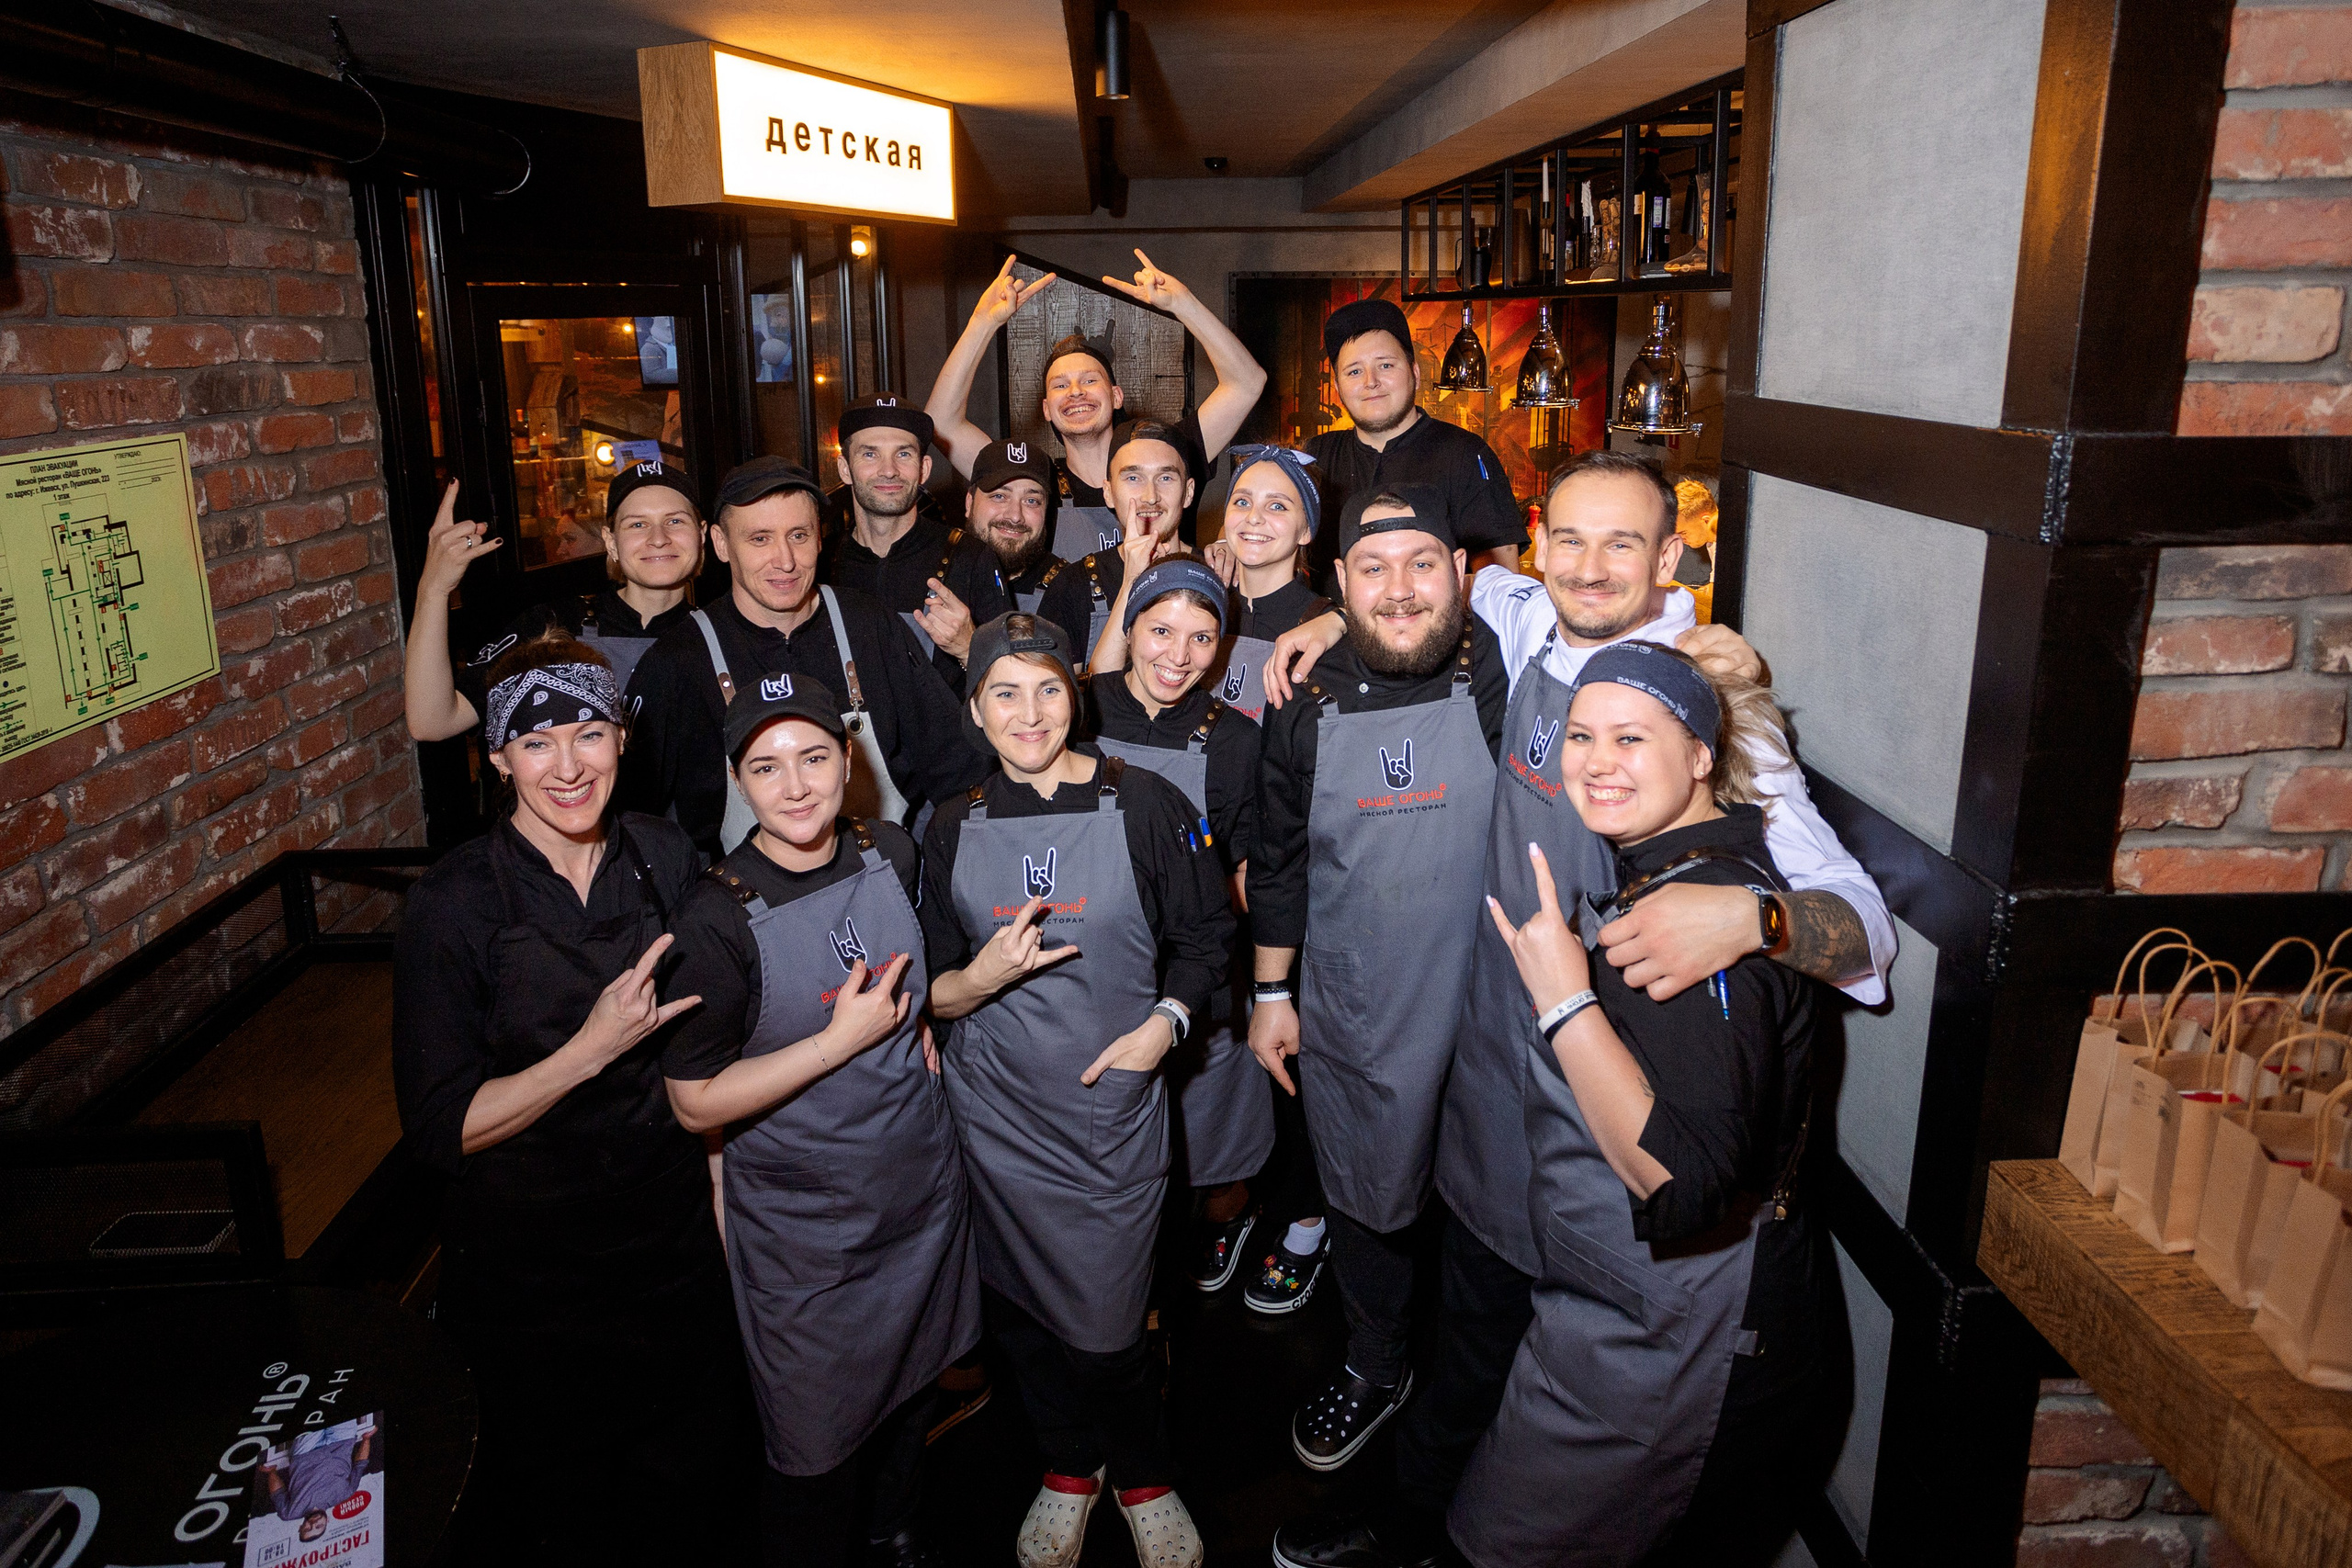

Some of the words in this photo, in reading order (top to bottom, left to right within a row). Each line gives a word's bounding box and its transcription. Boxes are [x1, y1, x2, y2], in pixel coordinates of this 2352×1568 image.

[764, 116, 922, 171] детская
[29, 463, 45, 474] ПЛАН
[47, 460, 78, 471] ЭВАКУАЦИИ
[16, 476, 37, 486] Мясной
[38, 474, 62, 484] ресторан
[1360, 808, 1395, 818] МЯСНОЙ
[1397, 803, 1447, 815] РЕСТОРАН
